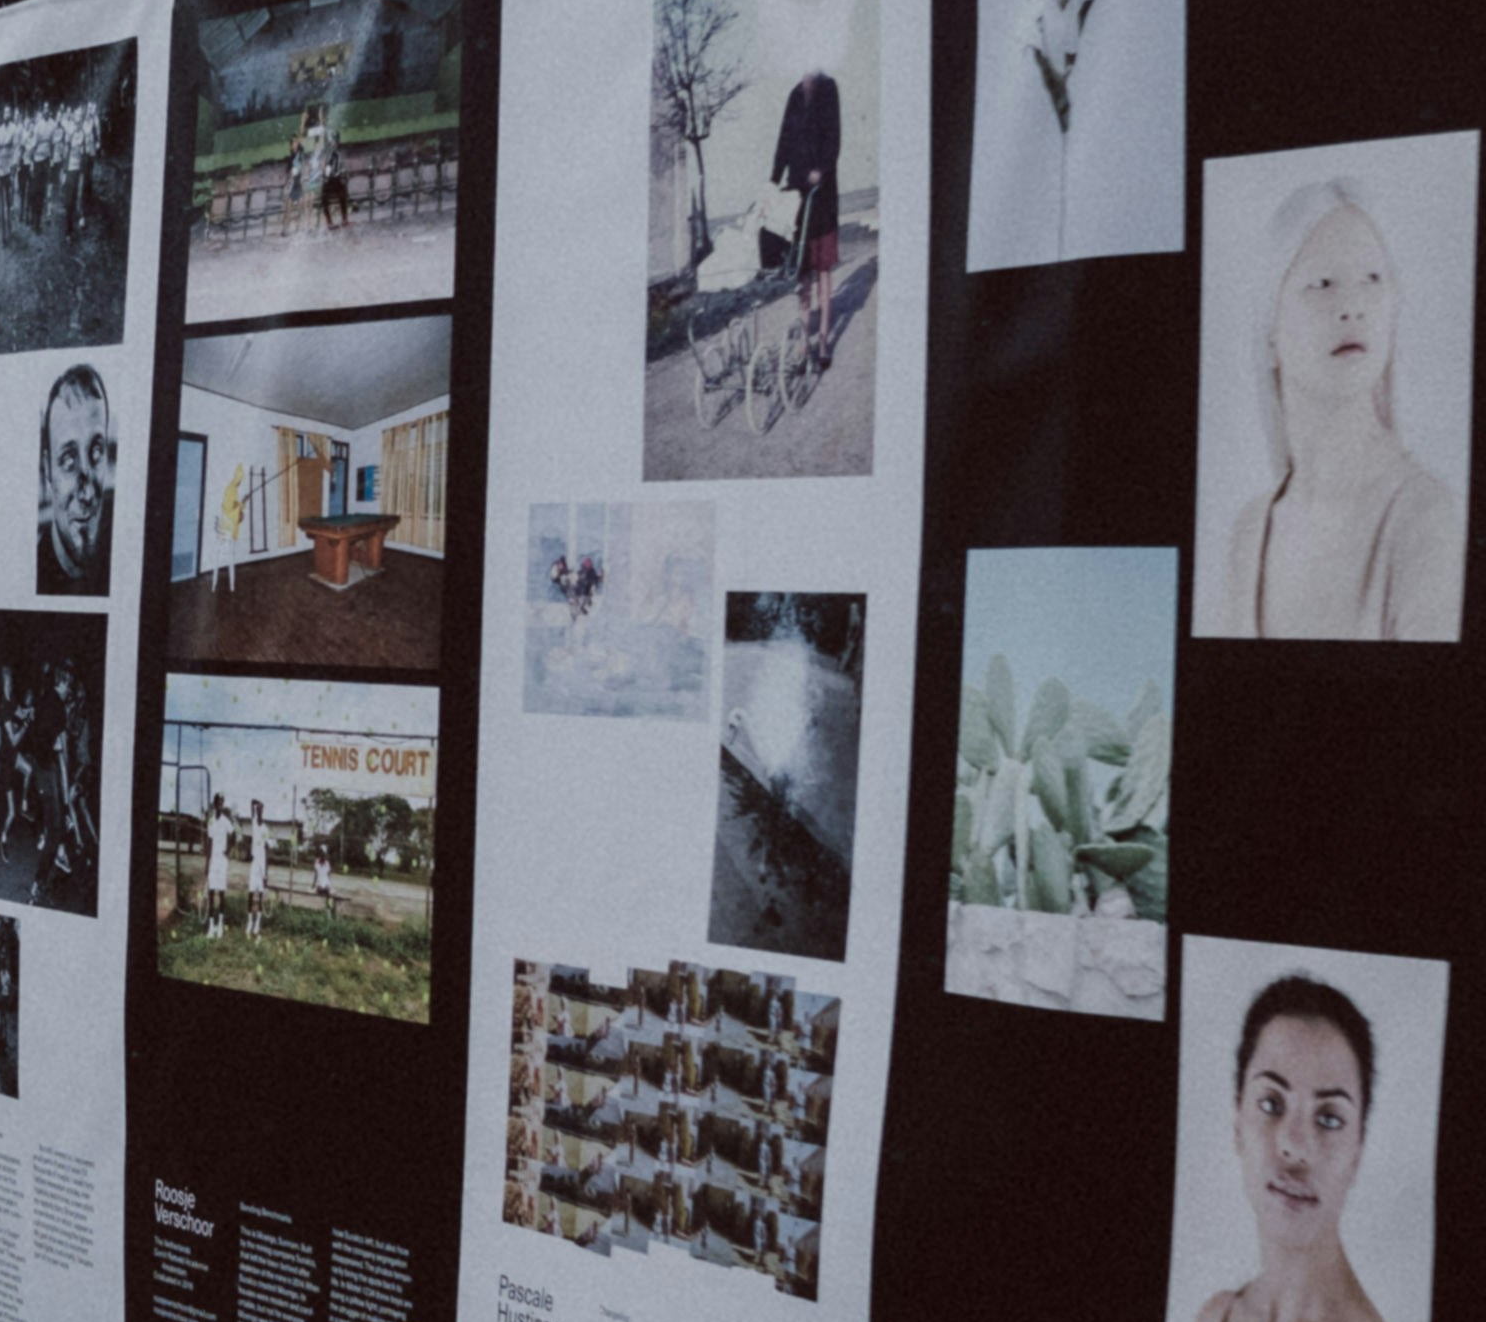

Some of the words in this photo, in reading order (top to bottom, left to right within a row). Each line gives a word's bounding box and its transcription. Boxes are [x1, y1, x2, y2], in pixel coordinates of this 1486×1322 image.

[301, 744, 358, 772] TENNIS
[366, 748, 430, 776] COURT
[154, 1178, 197, 1211] Roosje
[154, 1201, 215, 1239] Verschoor
[498, 1275, 554, 1313] Pascale
